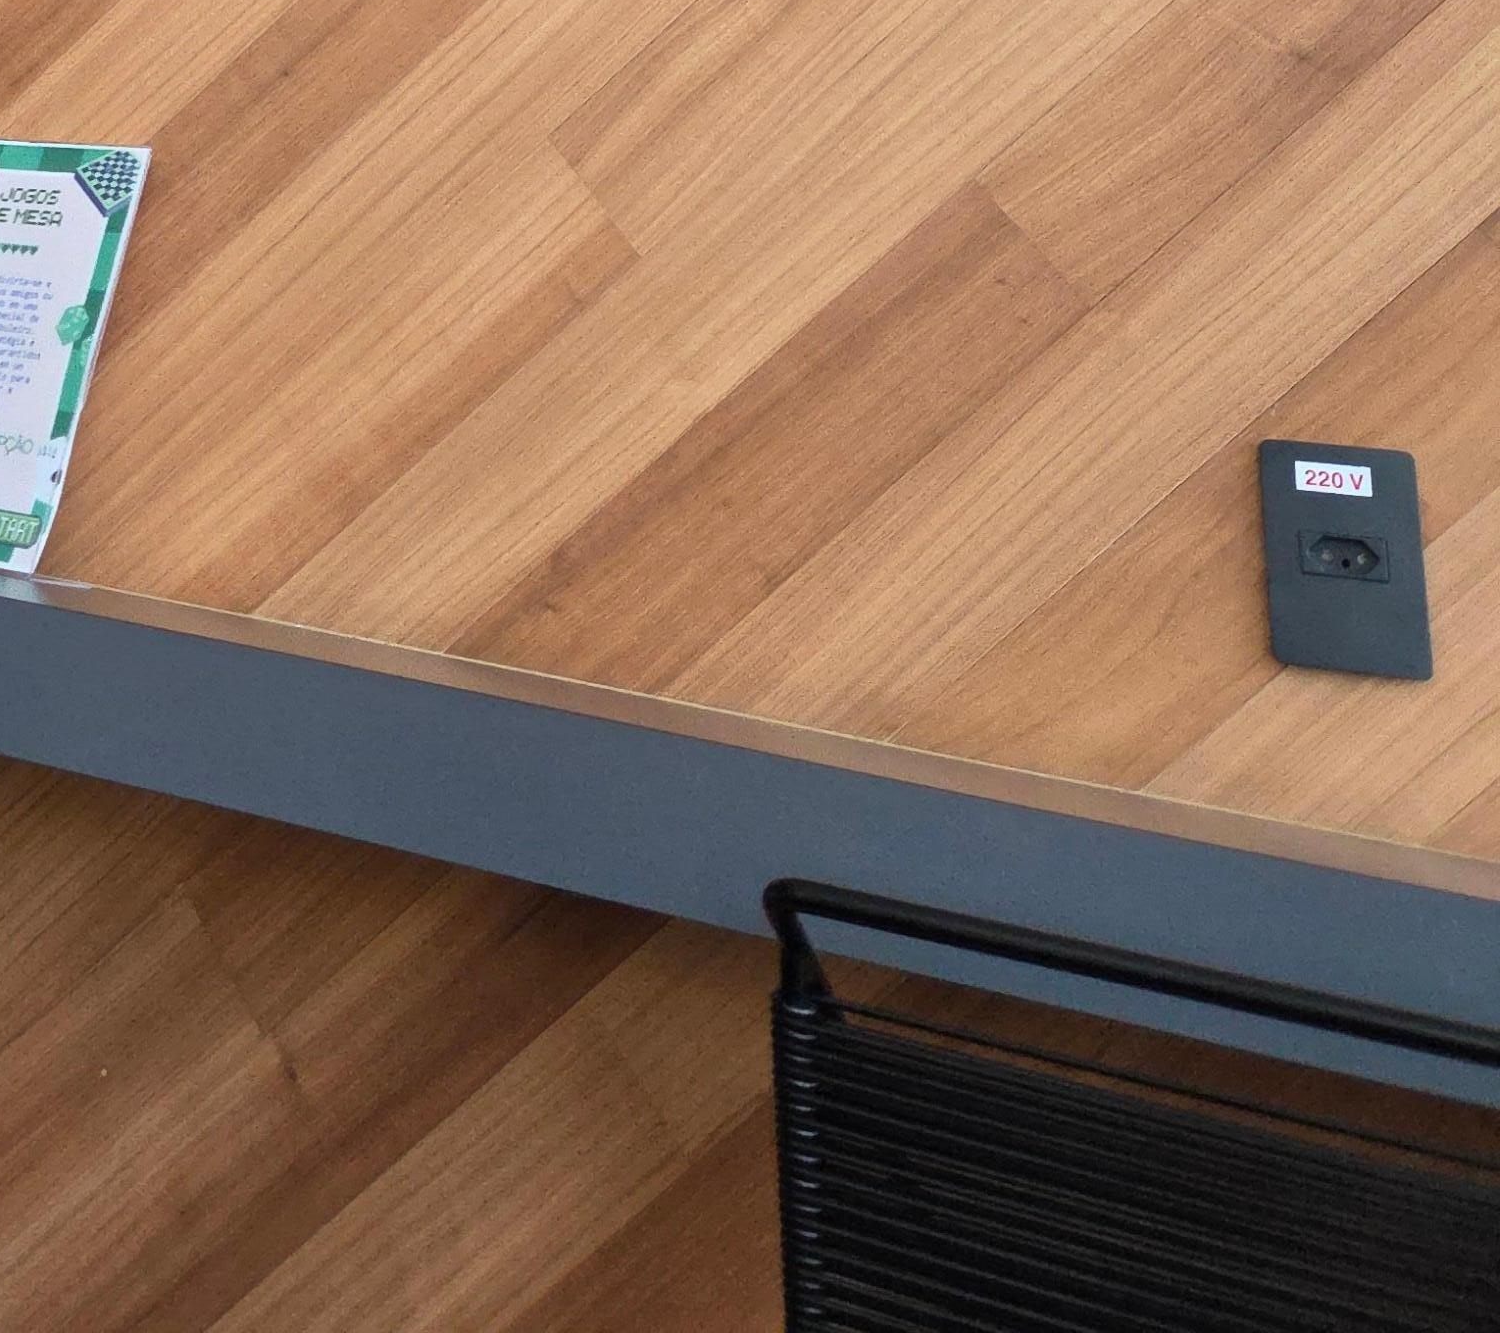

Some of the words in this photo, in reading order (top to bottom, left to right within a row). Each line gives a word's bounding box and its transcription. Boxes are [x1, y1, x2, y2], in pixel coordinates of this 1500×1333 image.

[0, 188, 61, 205] JOGOS
[13, 208, 63, 226] MESA
[1305, 469, 1344, 488] 220
[1349, 473, 1363, 490] V
